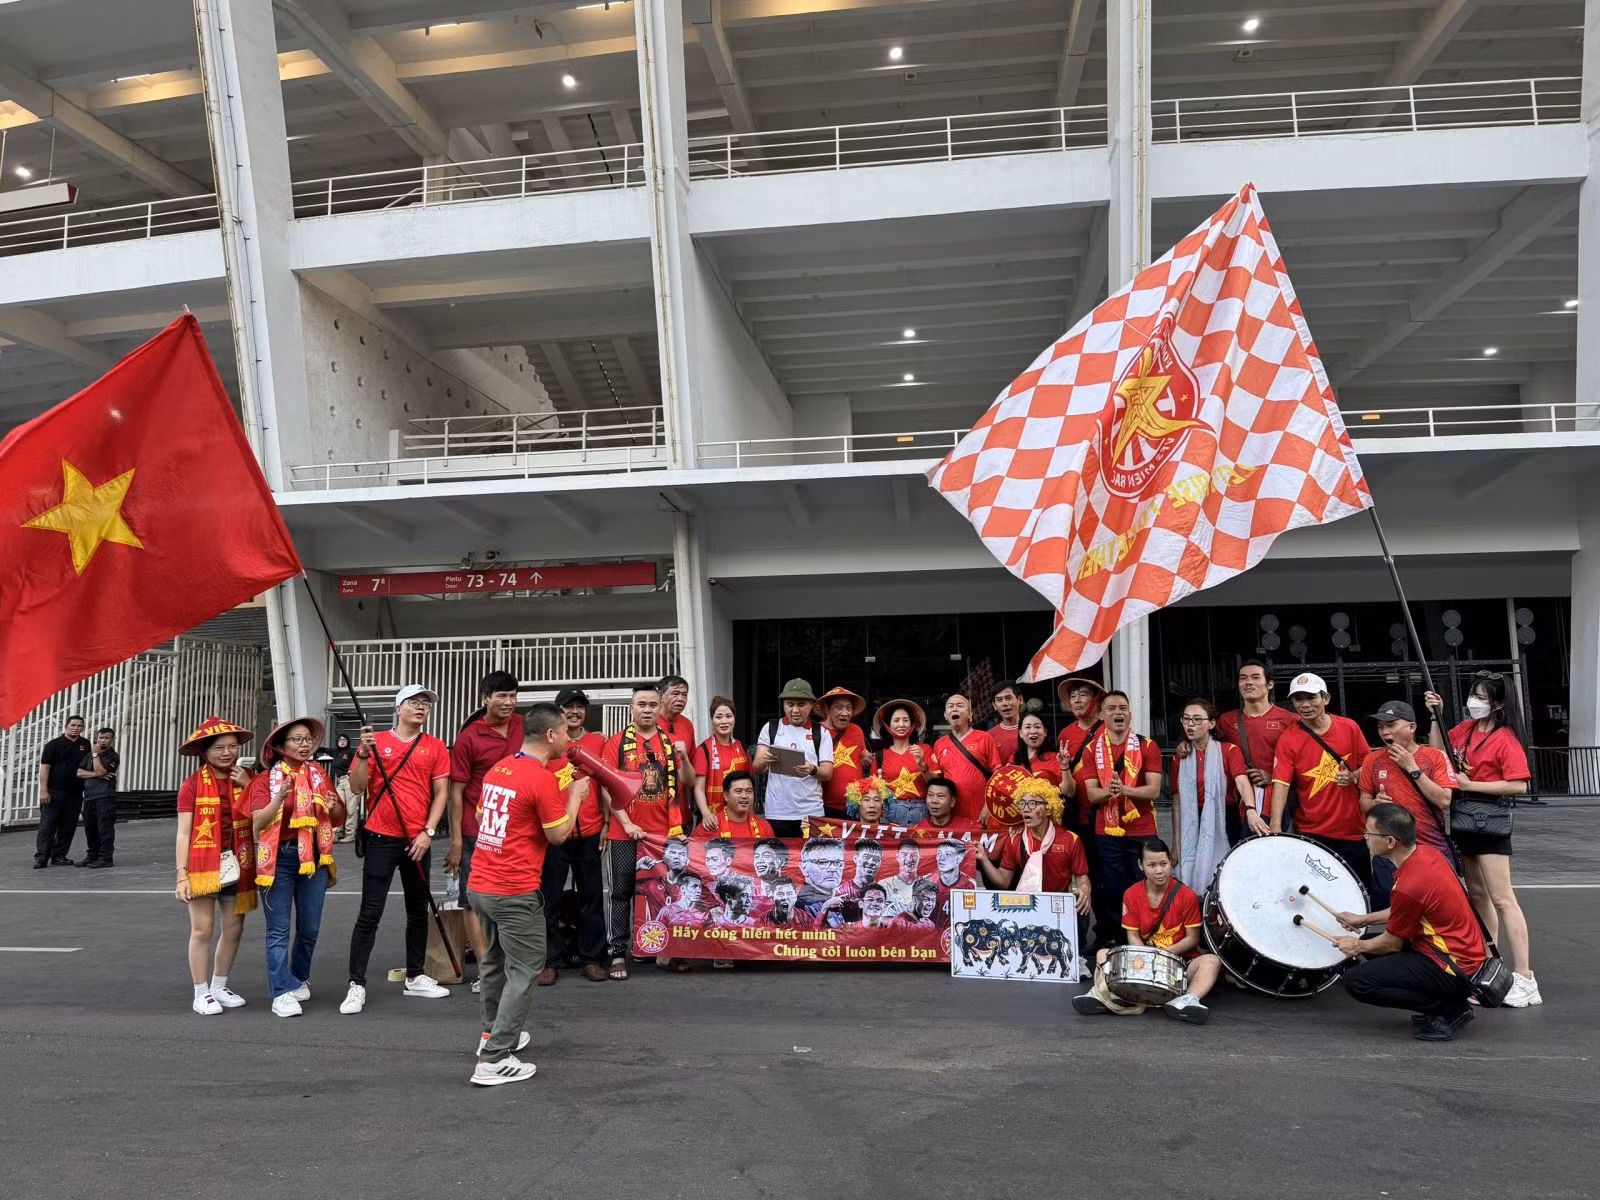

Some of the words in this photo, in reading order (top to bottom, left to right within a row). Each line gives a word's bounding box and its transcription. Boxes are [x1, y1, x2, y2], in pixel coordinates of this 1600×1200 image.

[467, 574, 484, 588] 73
[499, 572, 517, 586] 74
[479, 807, 510, 838] AM
[1307, 859, 1332, 879] REMO
[672, 925, 699, 940] Hãy
[703, 926, 738, 941] cống
[741, 926, 771, 939] hiến
[775, 927, 798, 940] hết
[802, 927, 836, 941] mình
[773, 944, 818, 958] Chúng
[821, 945, 841, 957] tôi
[846, 945, 876, 958] luôn
[880, 945, 906, 958] bên
[911, 945, 937, 960] bạn
